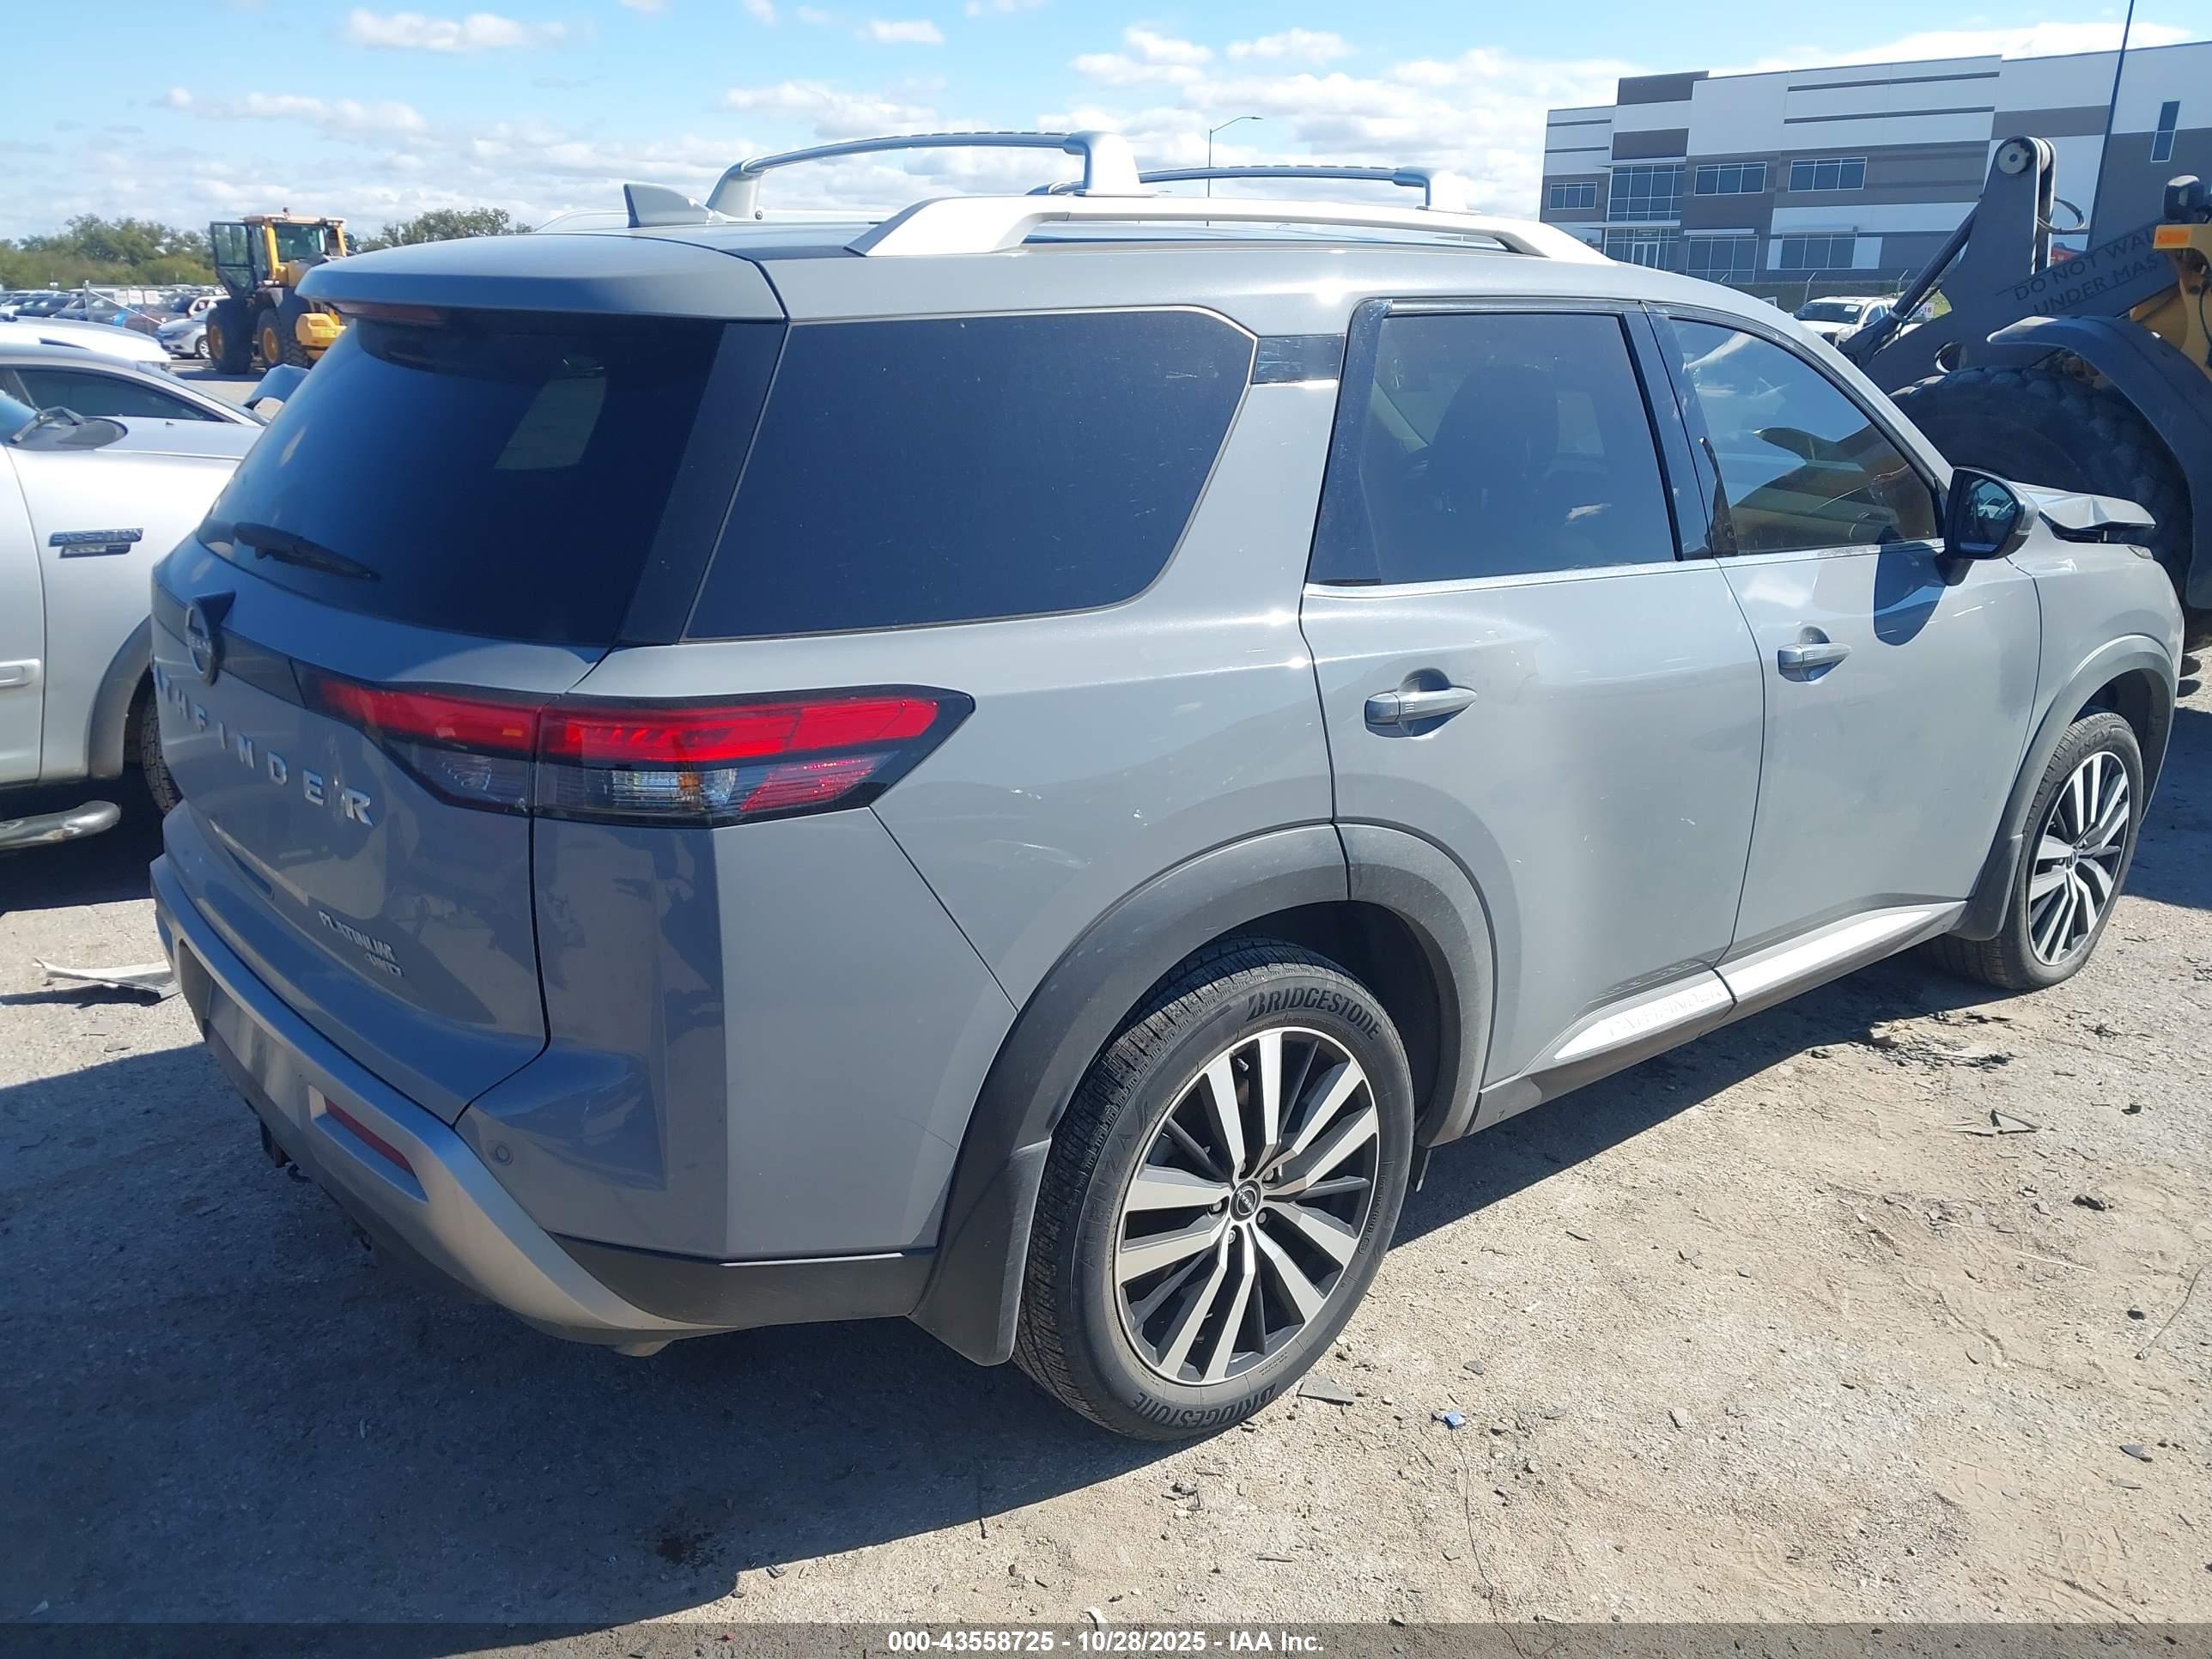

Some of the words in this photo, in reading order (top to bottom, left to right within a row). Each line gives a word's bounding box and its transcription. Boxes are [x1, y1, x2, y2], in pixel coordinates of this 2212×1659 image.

[2014, 277, 2046, 301] DO
[2052, 255, 2096, 284] NOT
[2105, 229, 2153, 259] WAL
[2033, 276, 2108, 315] UNDER
[2113, 252, 2158, 284] MAS
[1246, 988, 1382, 1041] BRIDGESTONE
[1128, 1382, 1278, 1429] BRIDGESTONE
